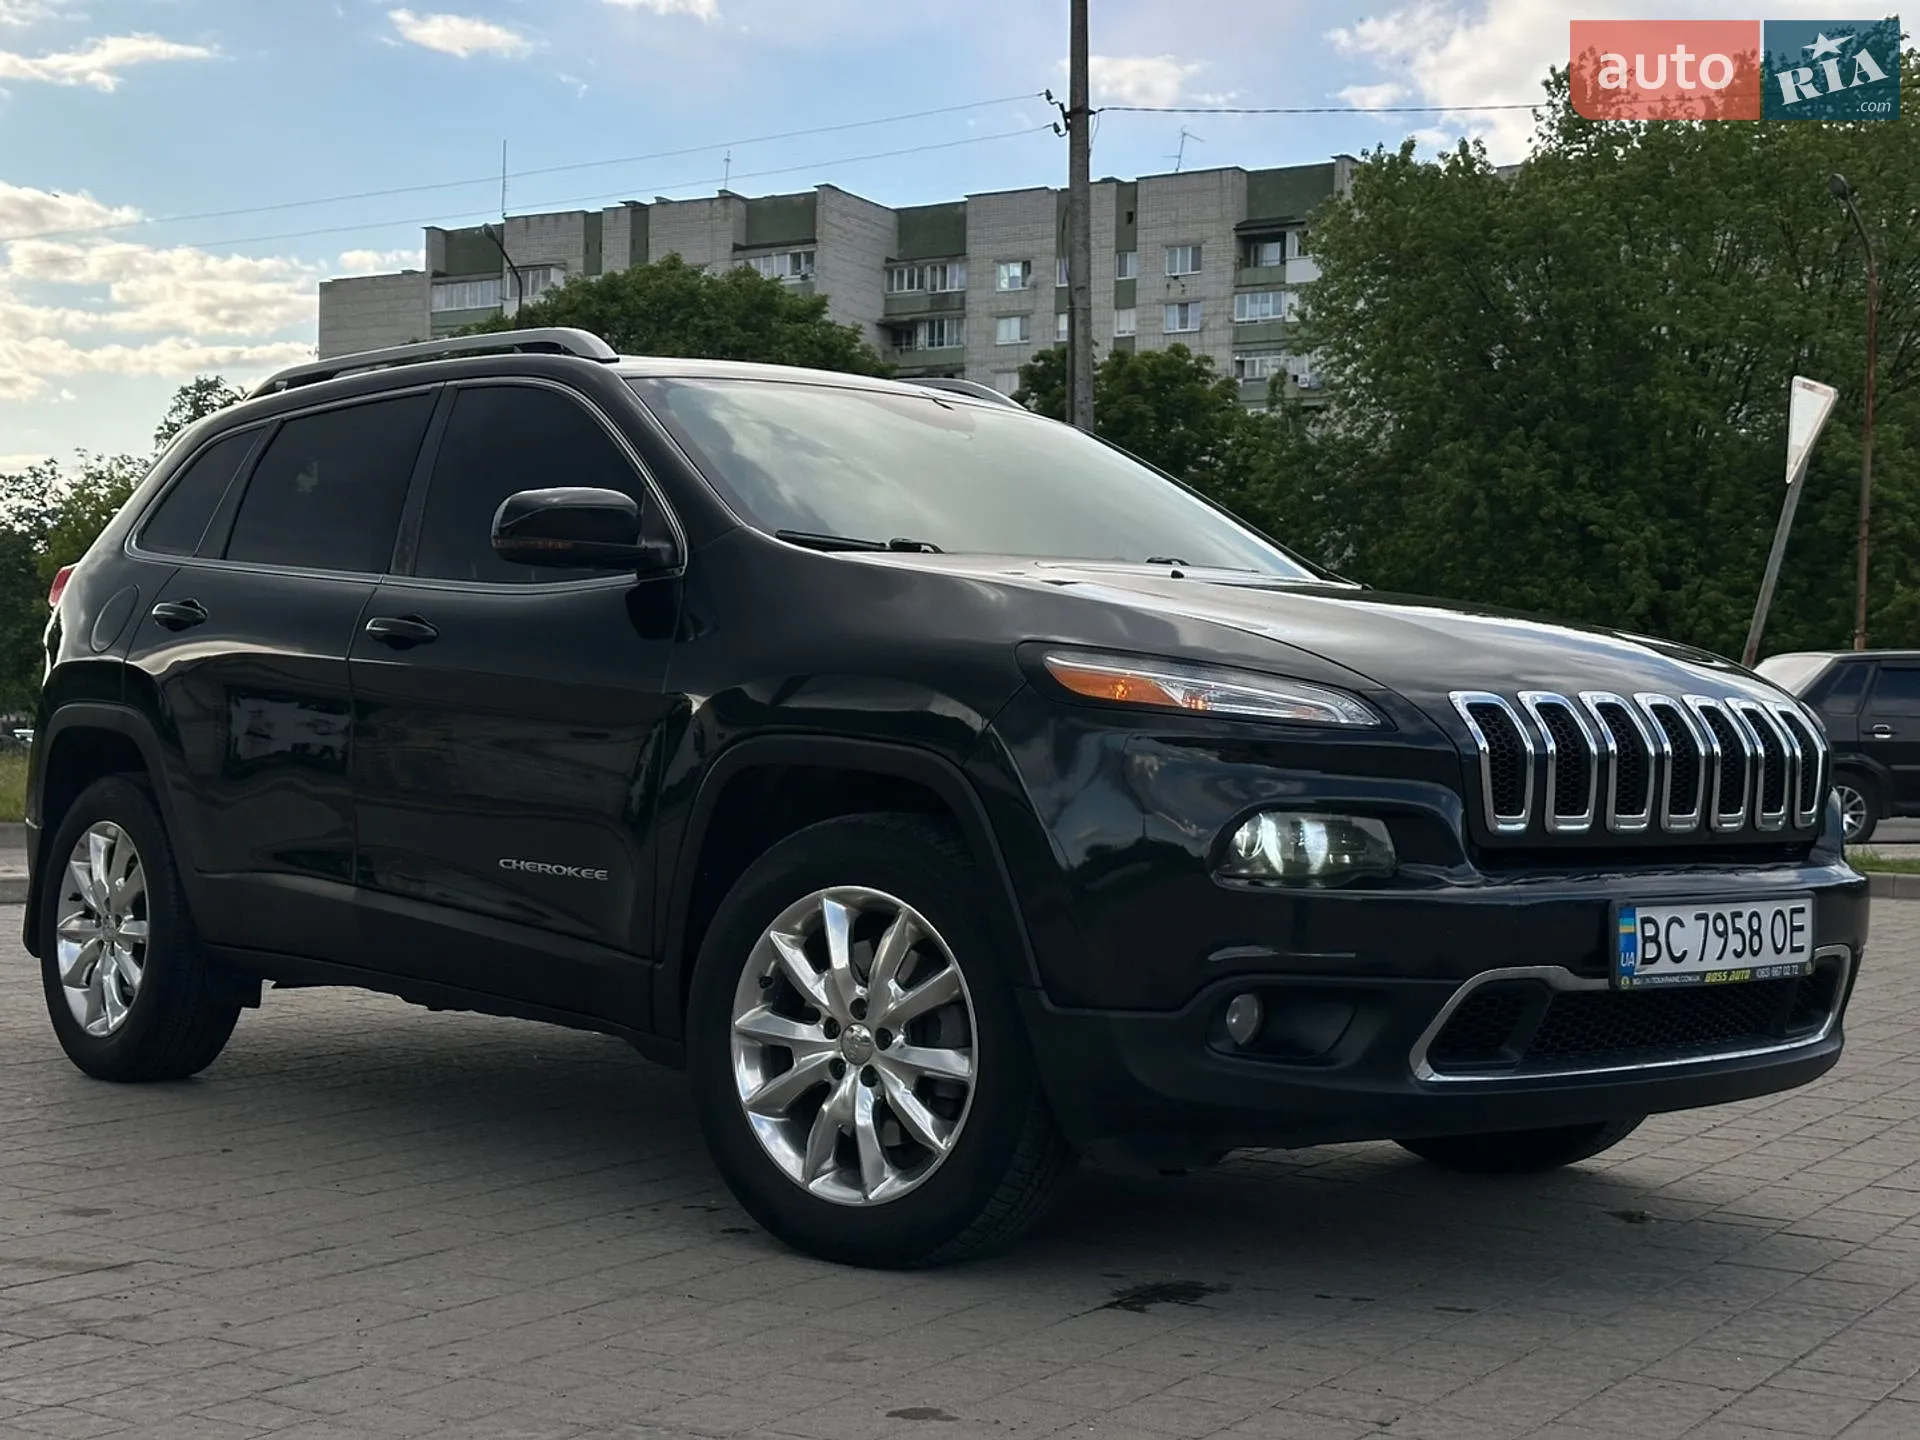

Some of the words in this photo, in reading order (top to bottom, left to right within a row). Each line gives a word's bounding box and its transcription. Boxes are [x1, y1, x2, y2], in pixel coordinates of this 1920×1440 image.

[499, 858, 609, 881] CHEROKEE
[1639, 915, 1688, 966] BC
[1694, 910, 1763, 961] 7958
[1770, 906, 1806, 955] OE
[1620, 951, 1635, 967] UA
[1704, 970, 1729, 983] BOSS
